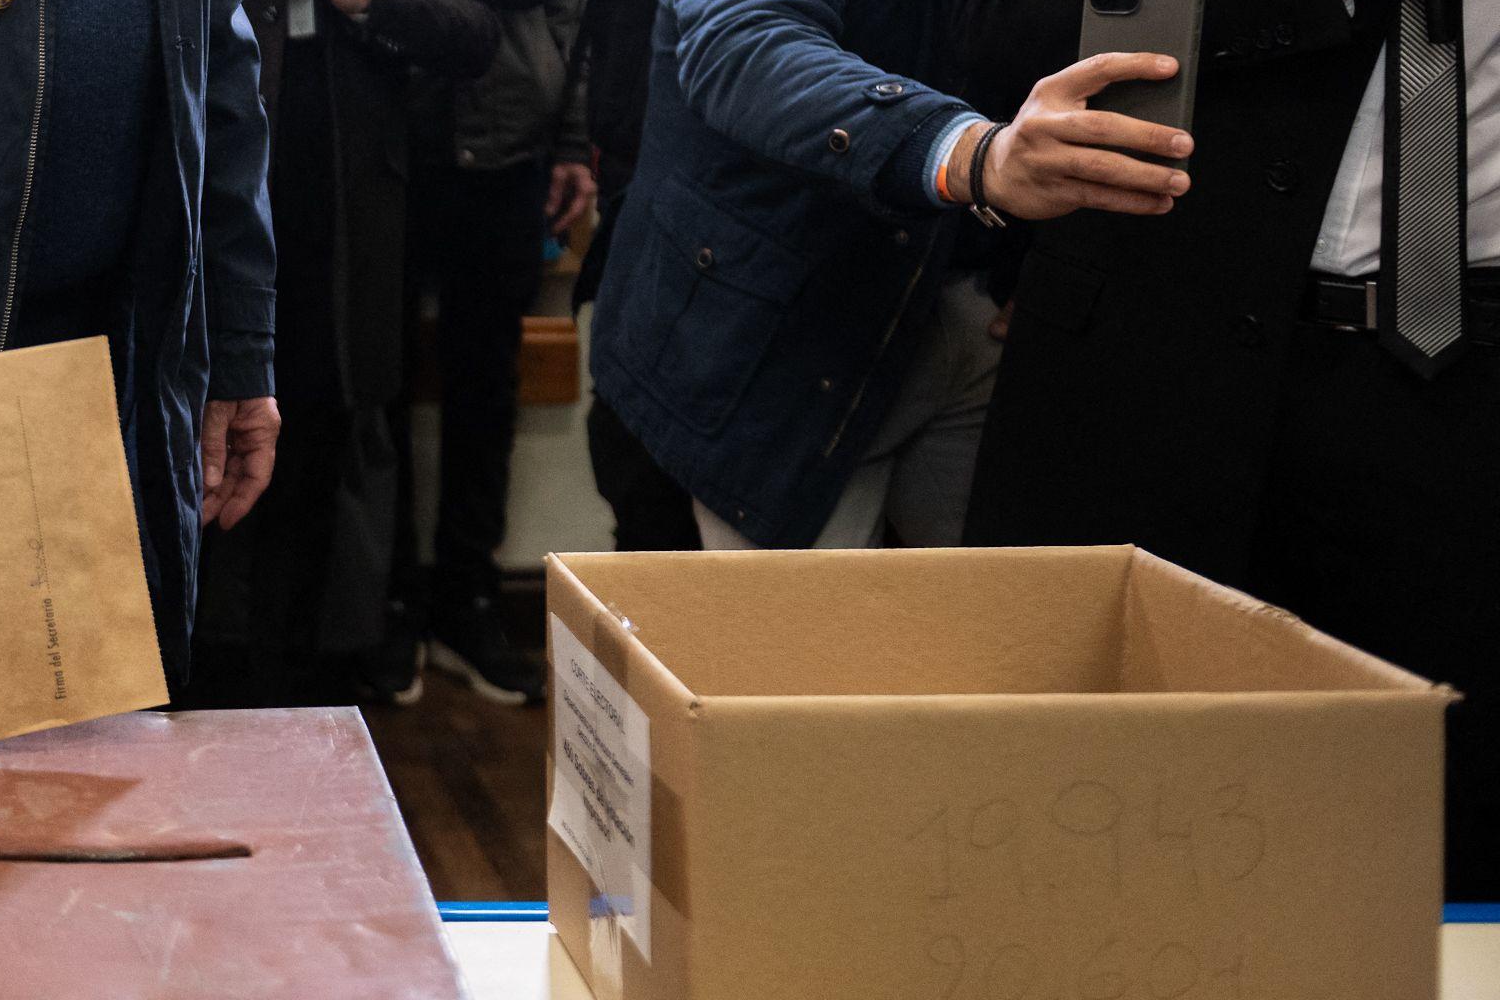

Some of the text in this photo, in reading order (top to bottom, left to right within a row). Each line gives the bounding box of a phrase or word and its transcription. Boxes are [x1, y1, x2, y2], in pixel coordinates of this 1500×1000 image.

[43, 598, 67, 700] Firma del Secretario
